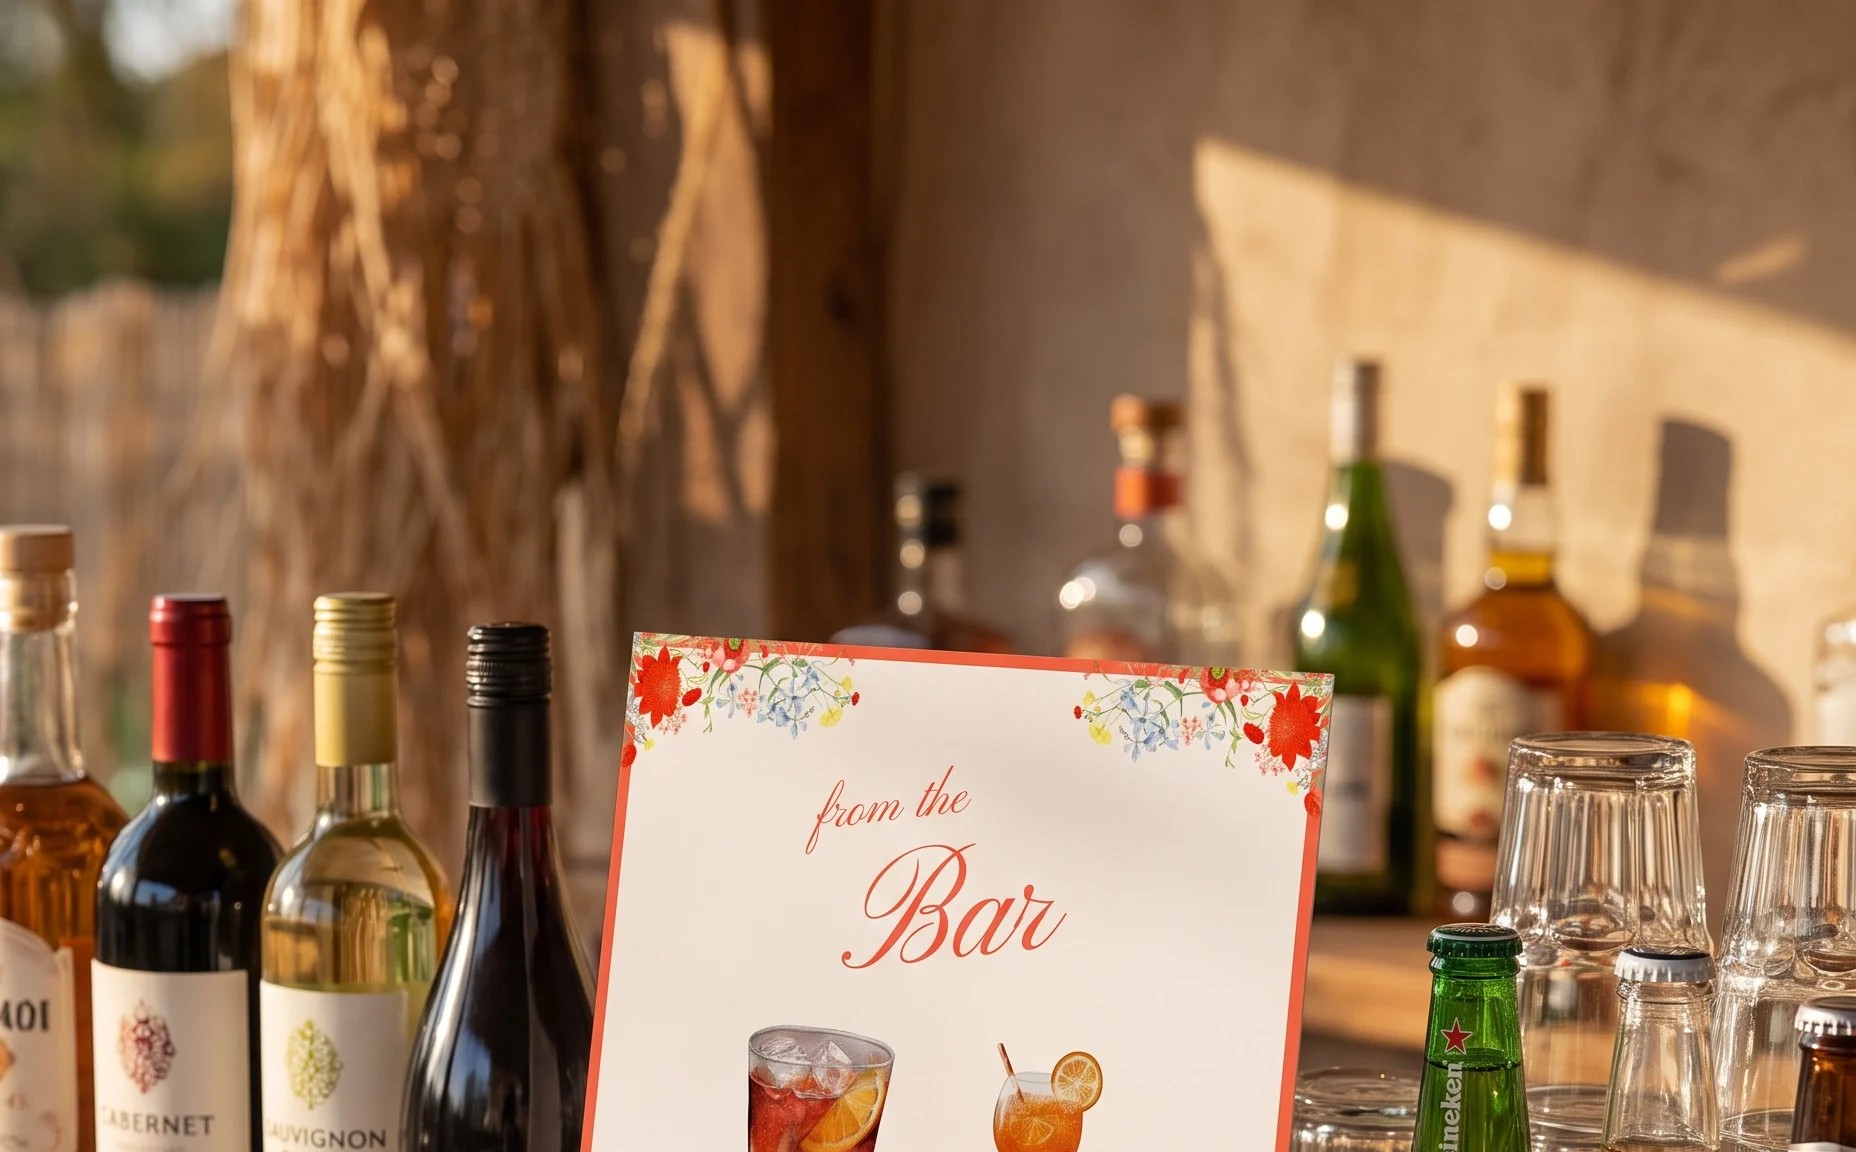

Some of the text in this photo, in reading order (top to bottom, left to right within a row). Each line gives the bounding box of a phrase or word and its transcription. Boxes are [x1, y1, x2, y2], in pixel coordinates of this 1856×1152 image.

[805, 765, 972, 855] from the
[841, 842, 1068, 969] Bar
